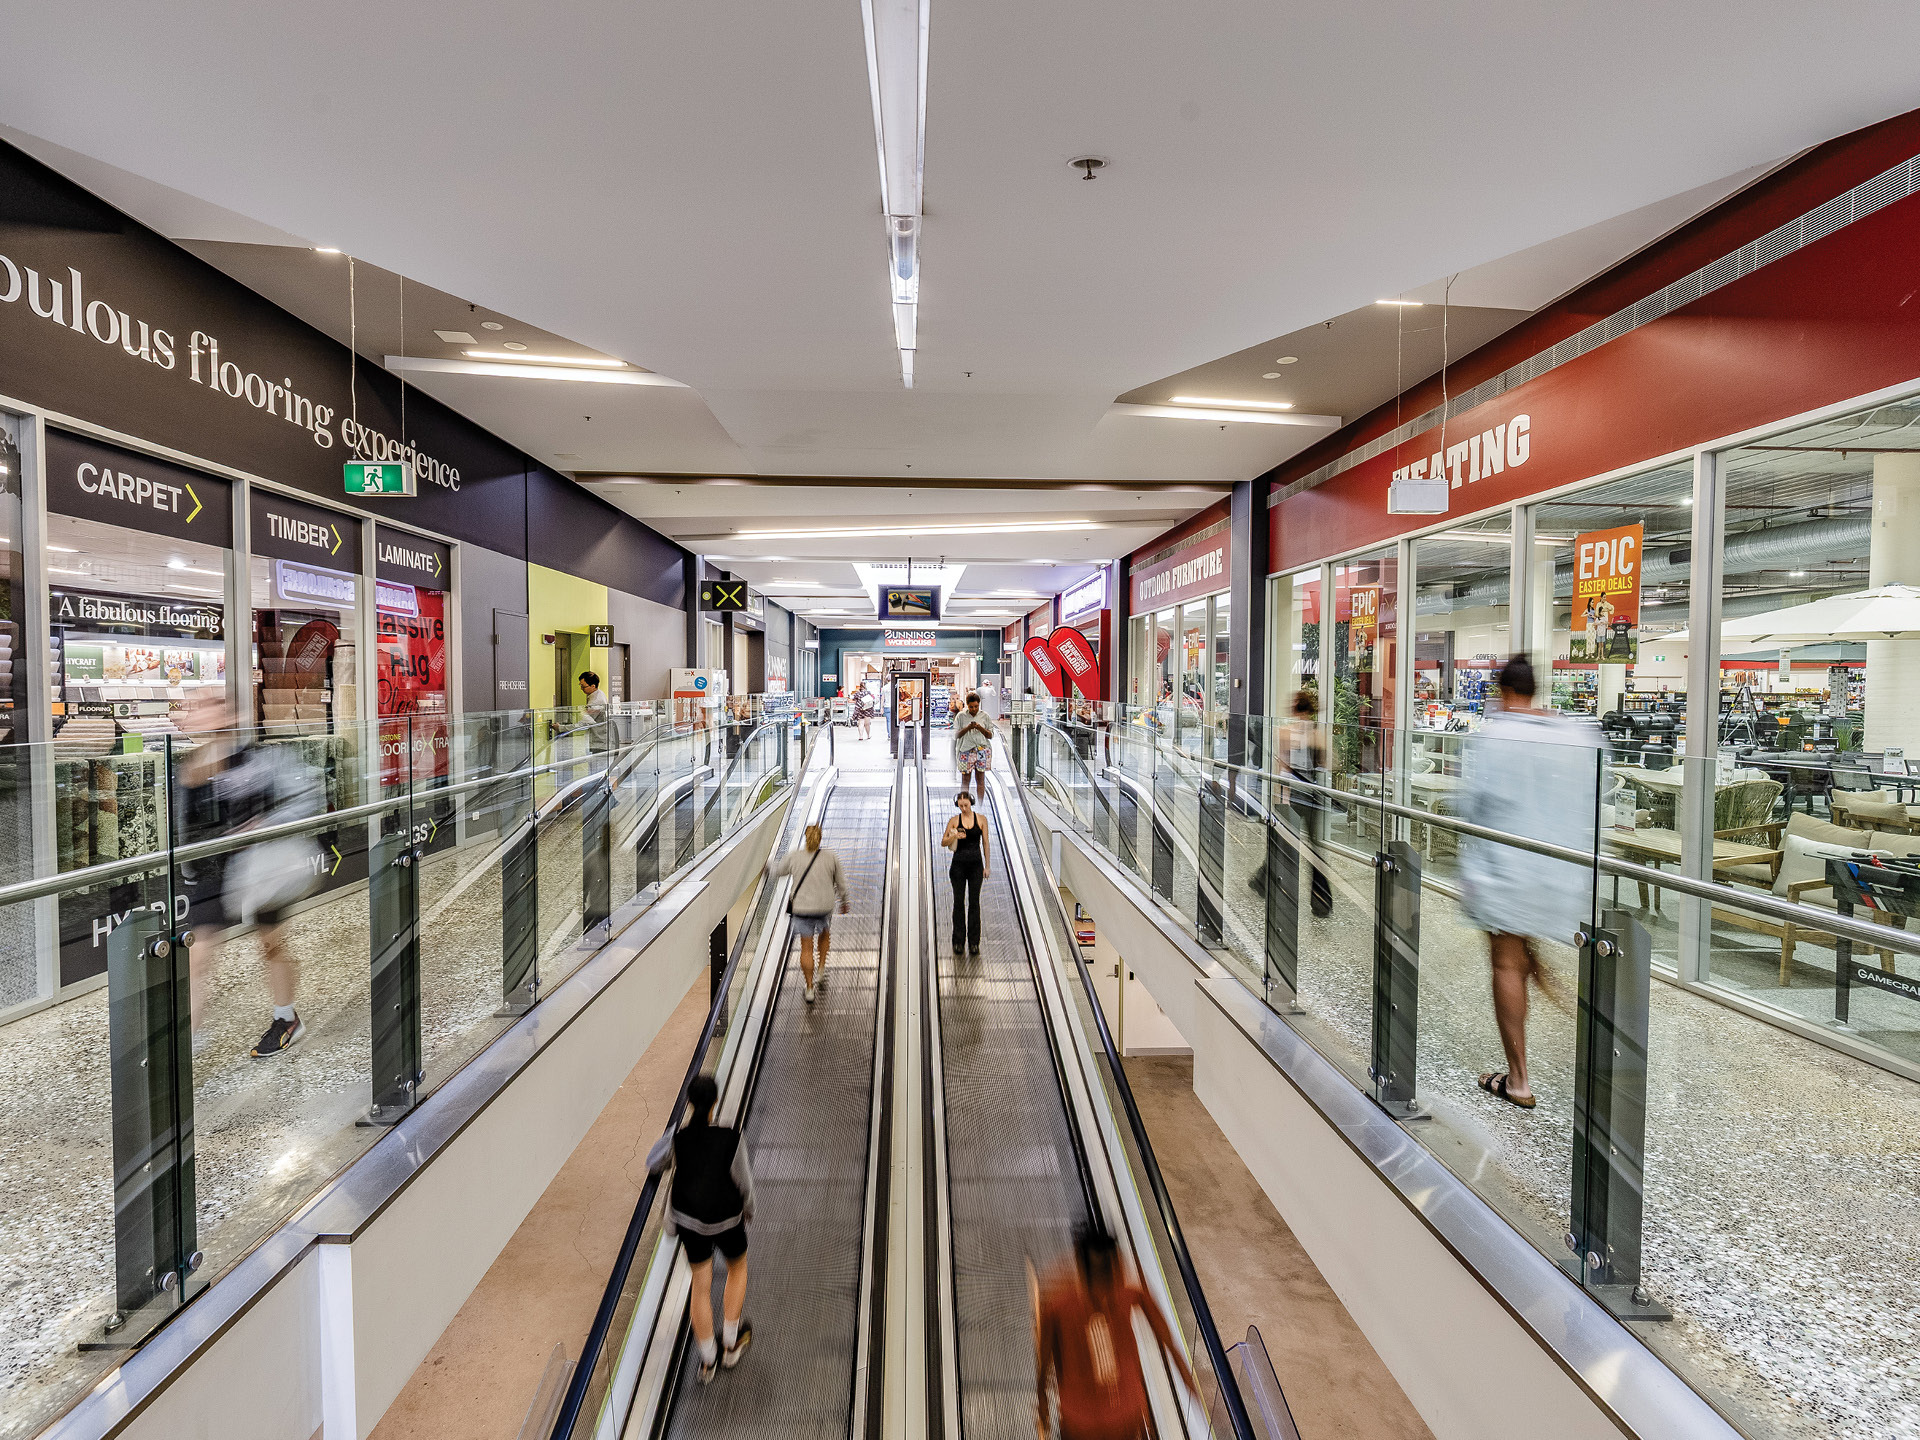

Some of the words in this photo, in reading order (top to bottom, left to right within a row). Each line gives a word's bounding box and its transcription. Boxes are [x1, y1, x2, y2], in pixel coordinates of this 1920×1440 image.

[188, 330, 334, 449] flooring
[341, 416, 461, 493] experience
[77, 462, 182, 514] CARPET
[267, 513, 330, 549] TIMBER
[378, 542, 434, 573] LAMINATE
[1579, 536, 1635, 580] EPIC
[1139, 570, 1171, 602] OUTDOOR
[1172, 547, 1223, 590] FURNITURE
[1579, 579, 1606, 593] EASTER
[1608, 576, 1633, 590] DEALS
[58, 597, 76, 617] A
[78, 597, 156, 624] fabulous
[159, 606, 220, 633] flooring
[1352, 589, 1376, 617] EPIC
[884, 629, 936, 639] BUNNINGS
[887, 638, 932, 646] warehouse
[65, 657, 97, 666] HYCRAFT
[390, 647, 430, 685] Rug
[1059, 645, 1082, 674] GALORE
[379, 740, 423, 757] LOORING
[1857, 968, 1920, 997] GAMECRA
